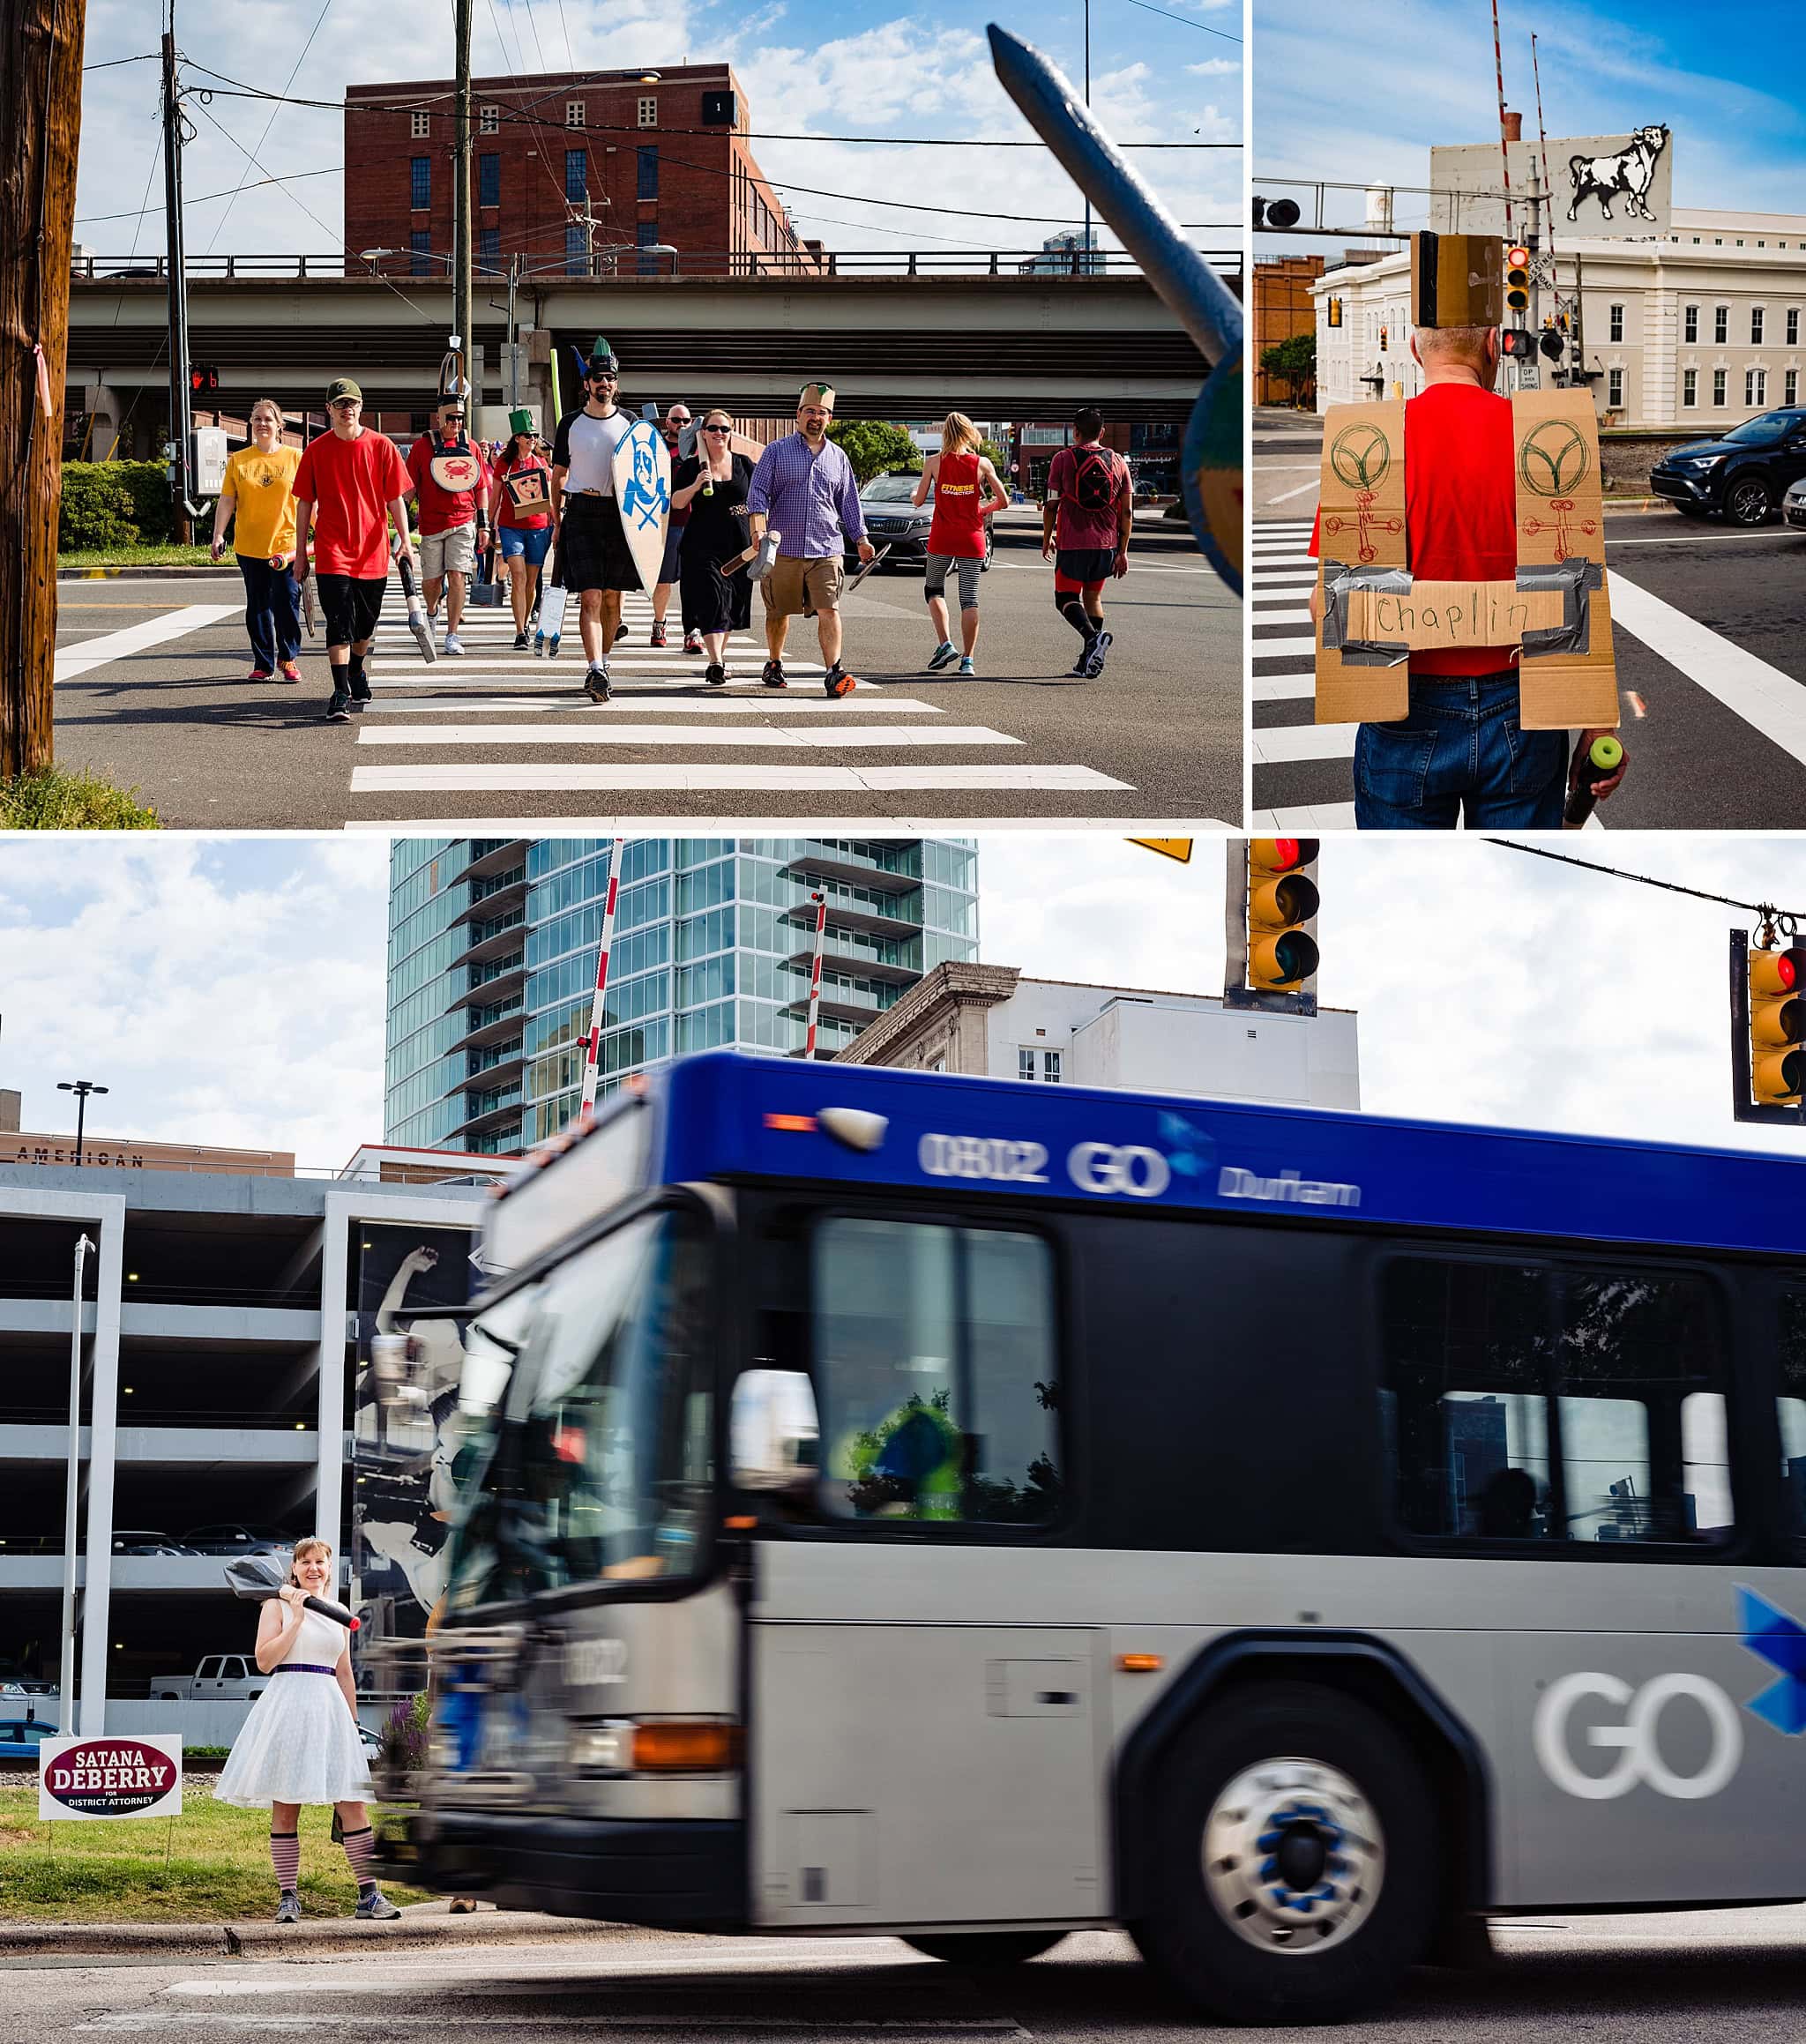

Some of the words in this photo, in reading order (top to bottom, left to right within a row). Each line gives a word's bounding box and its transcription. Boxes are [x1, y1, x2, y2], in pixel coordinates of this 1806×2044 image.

[17, 1146, 143, 1167] AMERICAN
[1067, 1141, 1171, 1197] GO
[1218, 1166, 1362, 1207] Durham
[1533, 1671, 1744, 1800] GO
[75, 1750, 146, 1768] SATANA
[54, 1766, 168, 1790] DEBERRY
[108, 1796, 153, 1806] ATTORNEY
